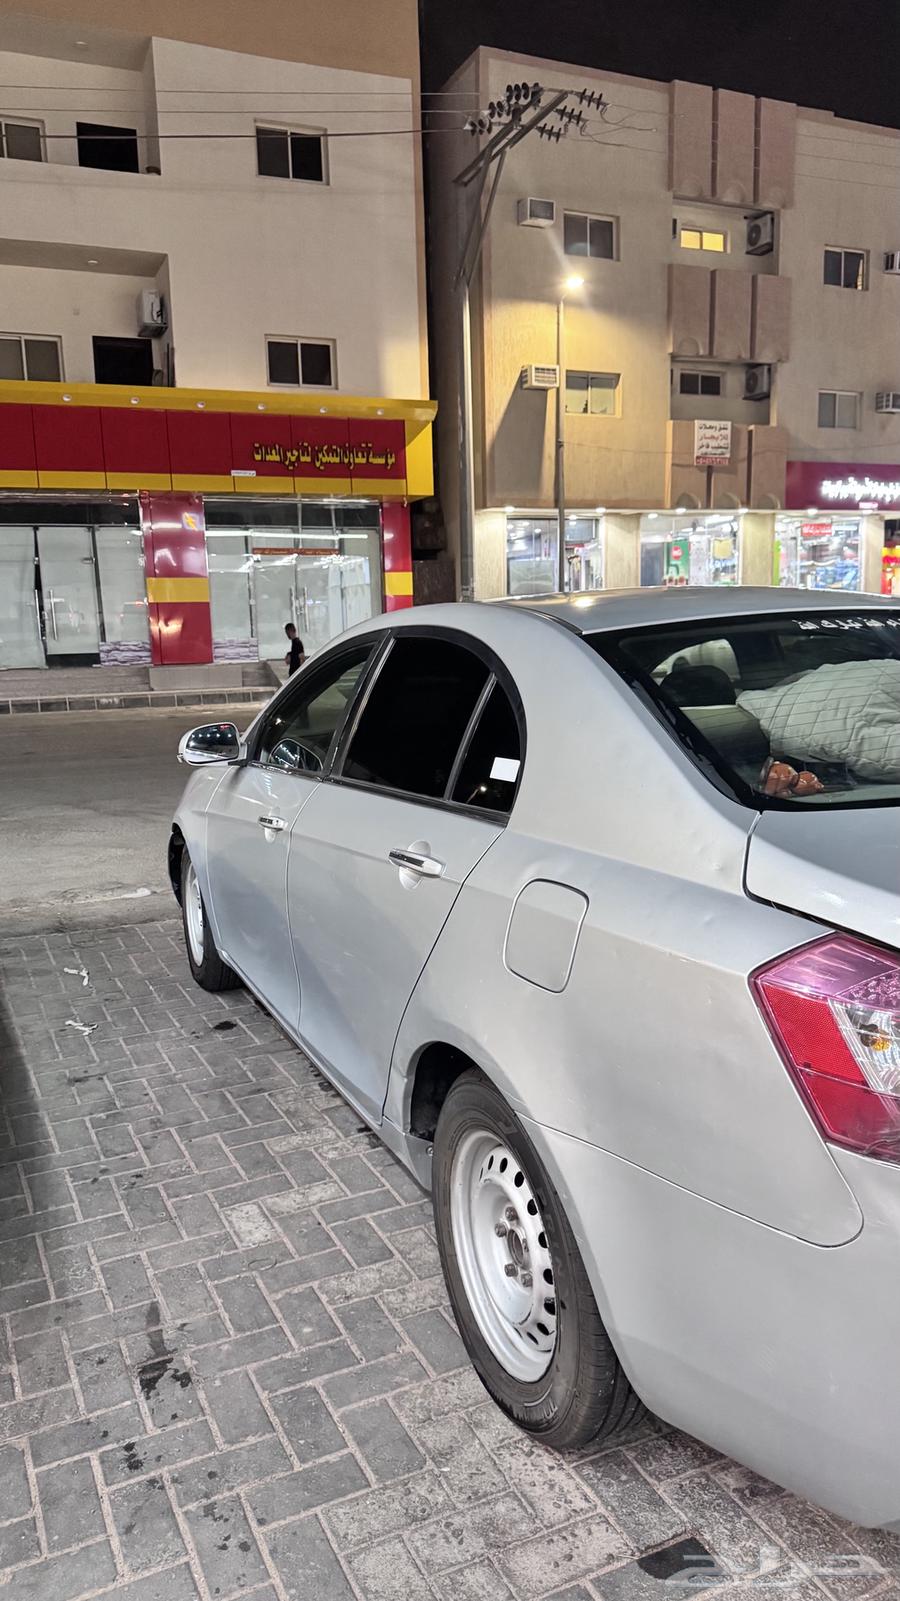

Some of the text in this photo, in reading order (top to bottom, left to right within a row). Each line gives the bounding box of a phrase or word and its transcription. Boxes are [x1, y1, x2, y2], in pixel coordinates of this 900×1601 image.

[254, 443, 284, 463] المعدات
[315, 444, 343, 470] التمكين
[344, 443, 367, 469] تعاون
[368, 444, 395, 469] مؤسسة
[792, 619, 820, 630] الله
[821, 619, 863, 630] تبارك
